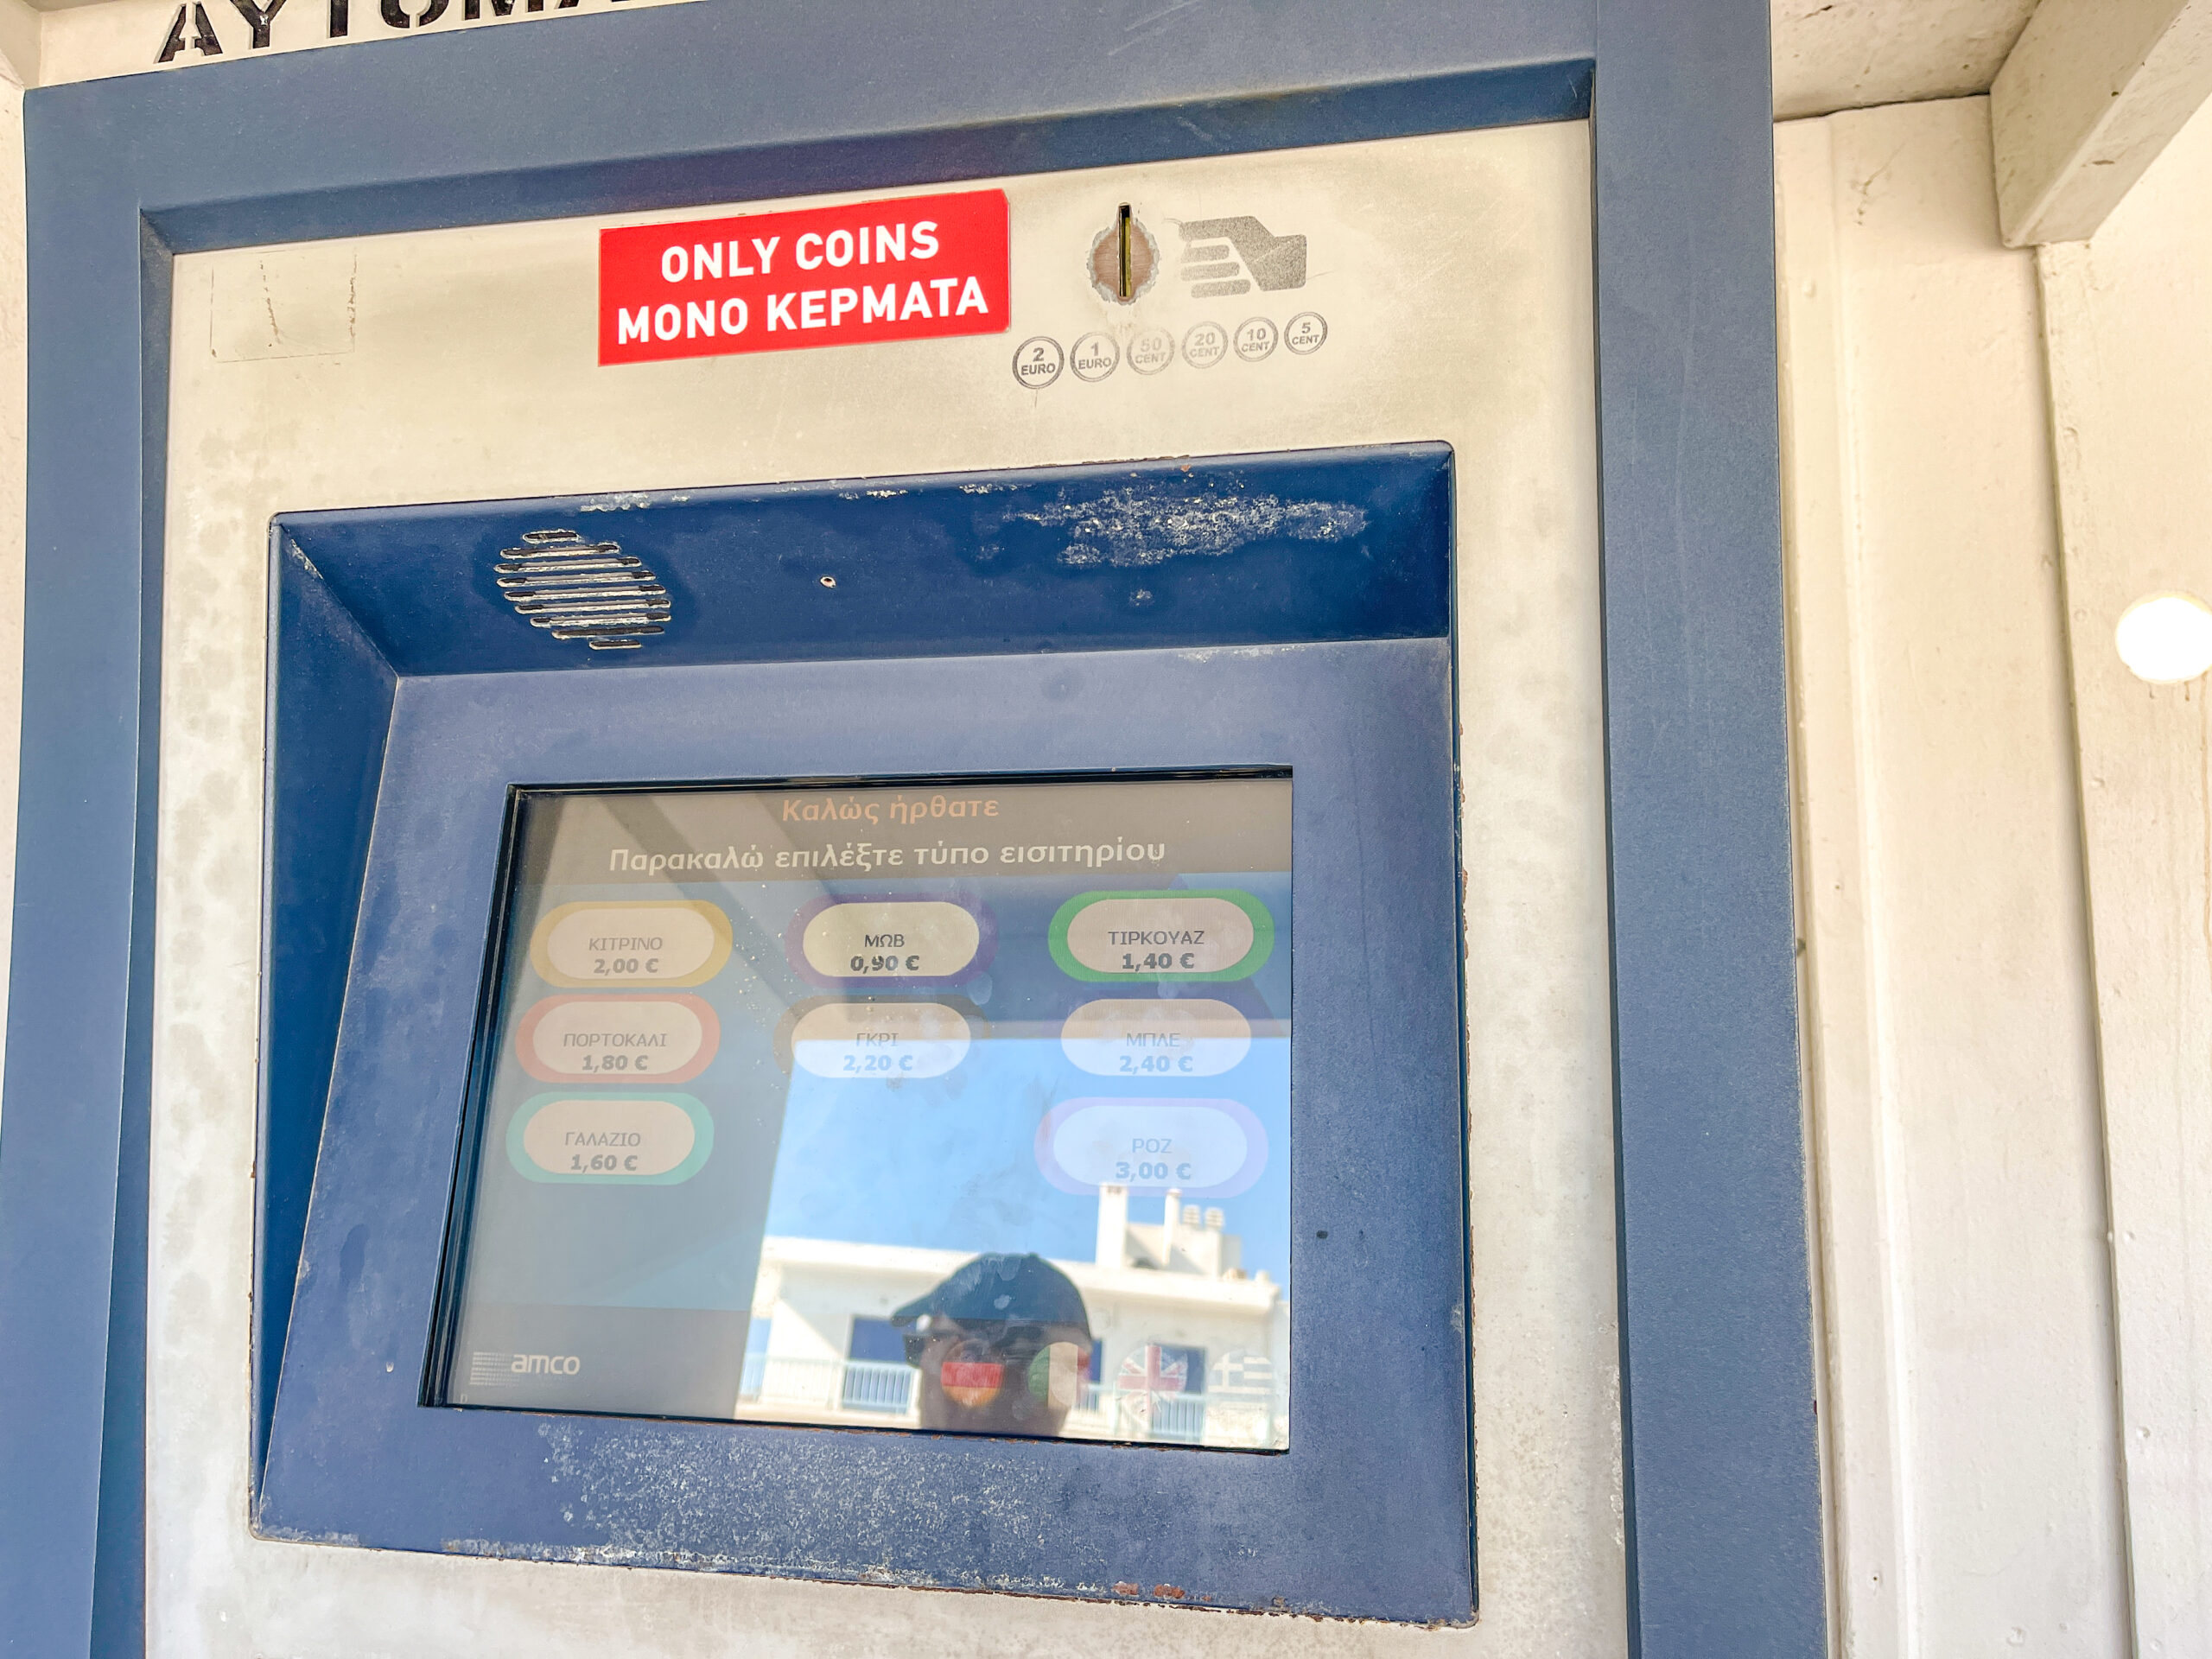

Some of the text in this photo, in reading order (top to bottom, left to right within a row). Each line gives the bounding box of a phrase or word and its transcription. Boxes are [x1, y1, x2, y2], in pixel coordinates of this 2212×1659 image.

[660, 220, 940, 283] ONLY COINS
[617, 276, 989, 345] ΜΟΝΟ ΚΕΡΜΑΤΑ
[1247, 327, 1267, 342] 10
[1301, 321, 1312, 335] 5
[1141, 338, 1162, 353] 50
[1194, 331, 1216, 346] 20
[1291, 334, 1321, 346] CENT
[1091, 341, 1100, 357] 1
[1189, 346, 1220, 358] CENT
[1241, 340, 1270, 353] CENT
[1033, 347, 1046, 363] 2
[1135, 353, 1166, 365] CENT
[1020, 364, 1056, 377] EURO
[1077, 358, 1113, 371] EURO
[782, 794, 1000, 825] Καλώς ήρθατε
[609, 836, 1166, 876] Παρακαλώ επιλέξτε τύπο εισιτηρίου
[588, 937, 664, 951] ΚΙΤΡΙΝΟ
[864, 934, 906, 948] ΜΩΒ
[1108, 931, 1205, 945] ΤΙΡΚΟΥΑΖ
[593, 958, 659, 976] 2,00 €
[849, 955, 920, 975] 0,90 €
[1122, 953, 1195, 972] 1,40 €
[563, 1033, 667, 1048] ΠΟΡΤΟΚΑΛΙ
[855, 1033, 900, 1047] ΓΚΡΙ
[1126, 1033, 1181, 1048] ΜΠΛΕ
[582, 1055, 649, 1074] 1,80 €
[842, 1055, 913, 1074] 2,20 €
[1119, 1055, 1193, 1074] 2,40 €
[564, 1132, 642, 1147] ΓΑΛΑΖΙΟ
[1132, 1138, 1173, 1154] ΡΟΖ
[570, 1154, 639, 1173] 1,60 €
[1116, 1161, 1192, 1181] 3,00 €
[511, 1354, 581, 1375] amco
